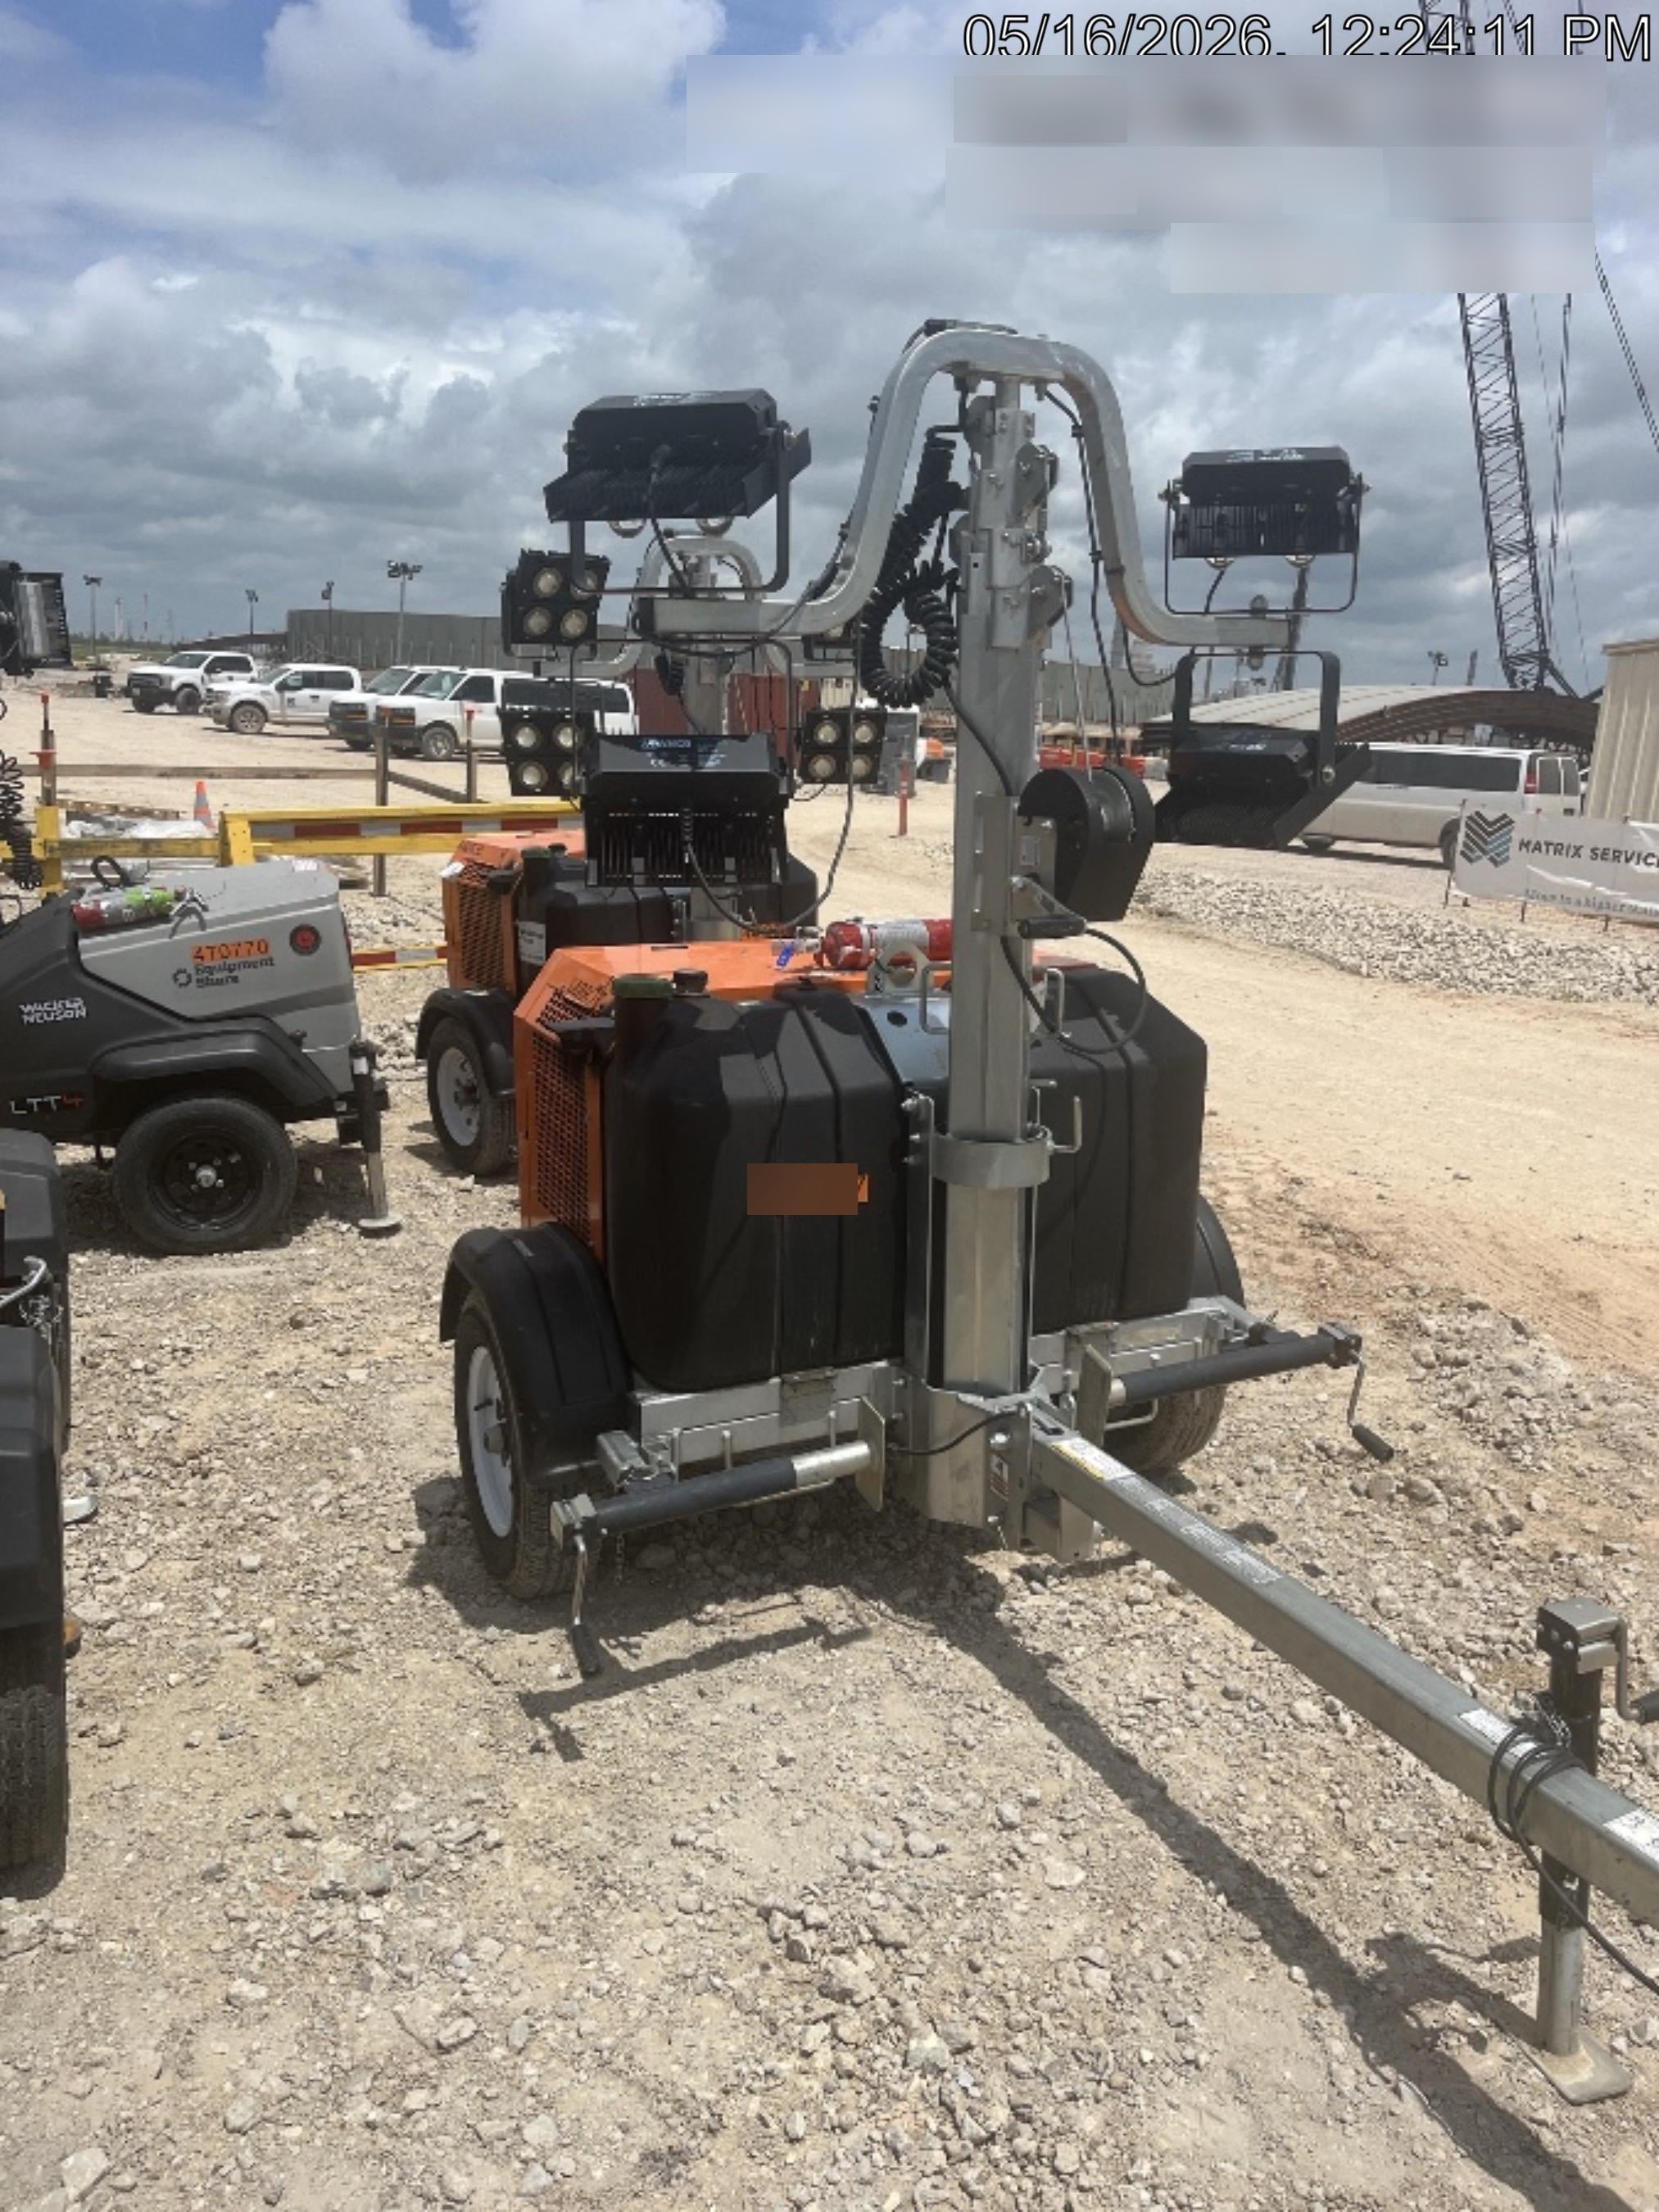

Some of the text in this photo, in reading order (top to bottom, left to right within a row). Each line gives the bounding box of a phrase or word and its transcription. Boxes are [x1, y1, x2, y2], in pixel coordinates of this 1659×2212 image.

[1518, 838, 1659, 868] MATRIX SERVIC
[195, 956, 275, 975] Equipment
[196, 975, 239, 988] Share
[20, 997, 84, 1013] WACKER
[22, 1006, 87, 1024] NEUSON
